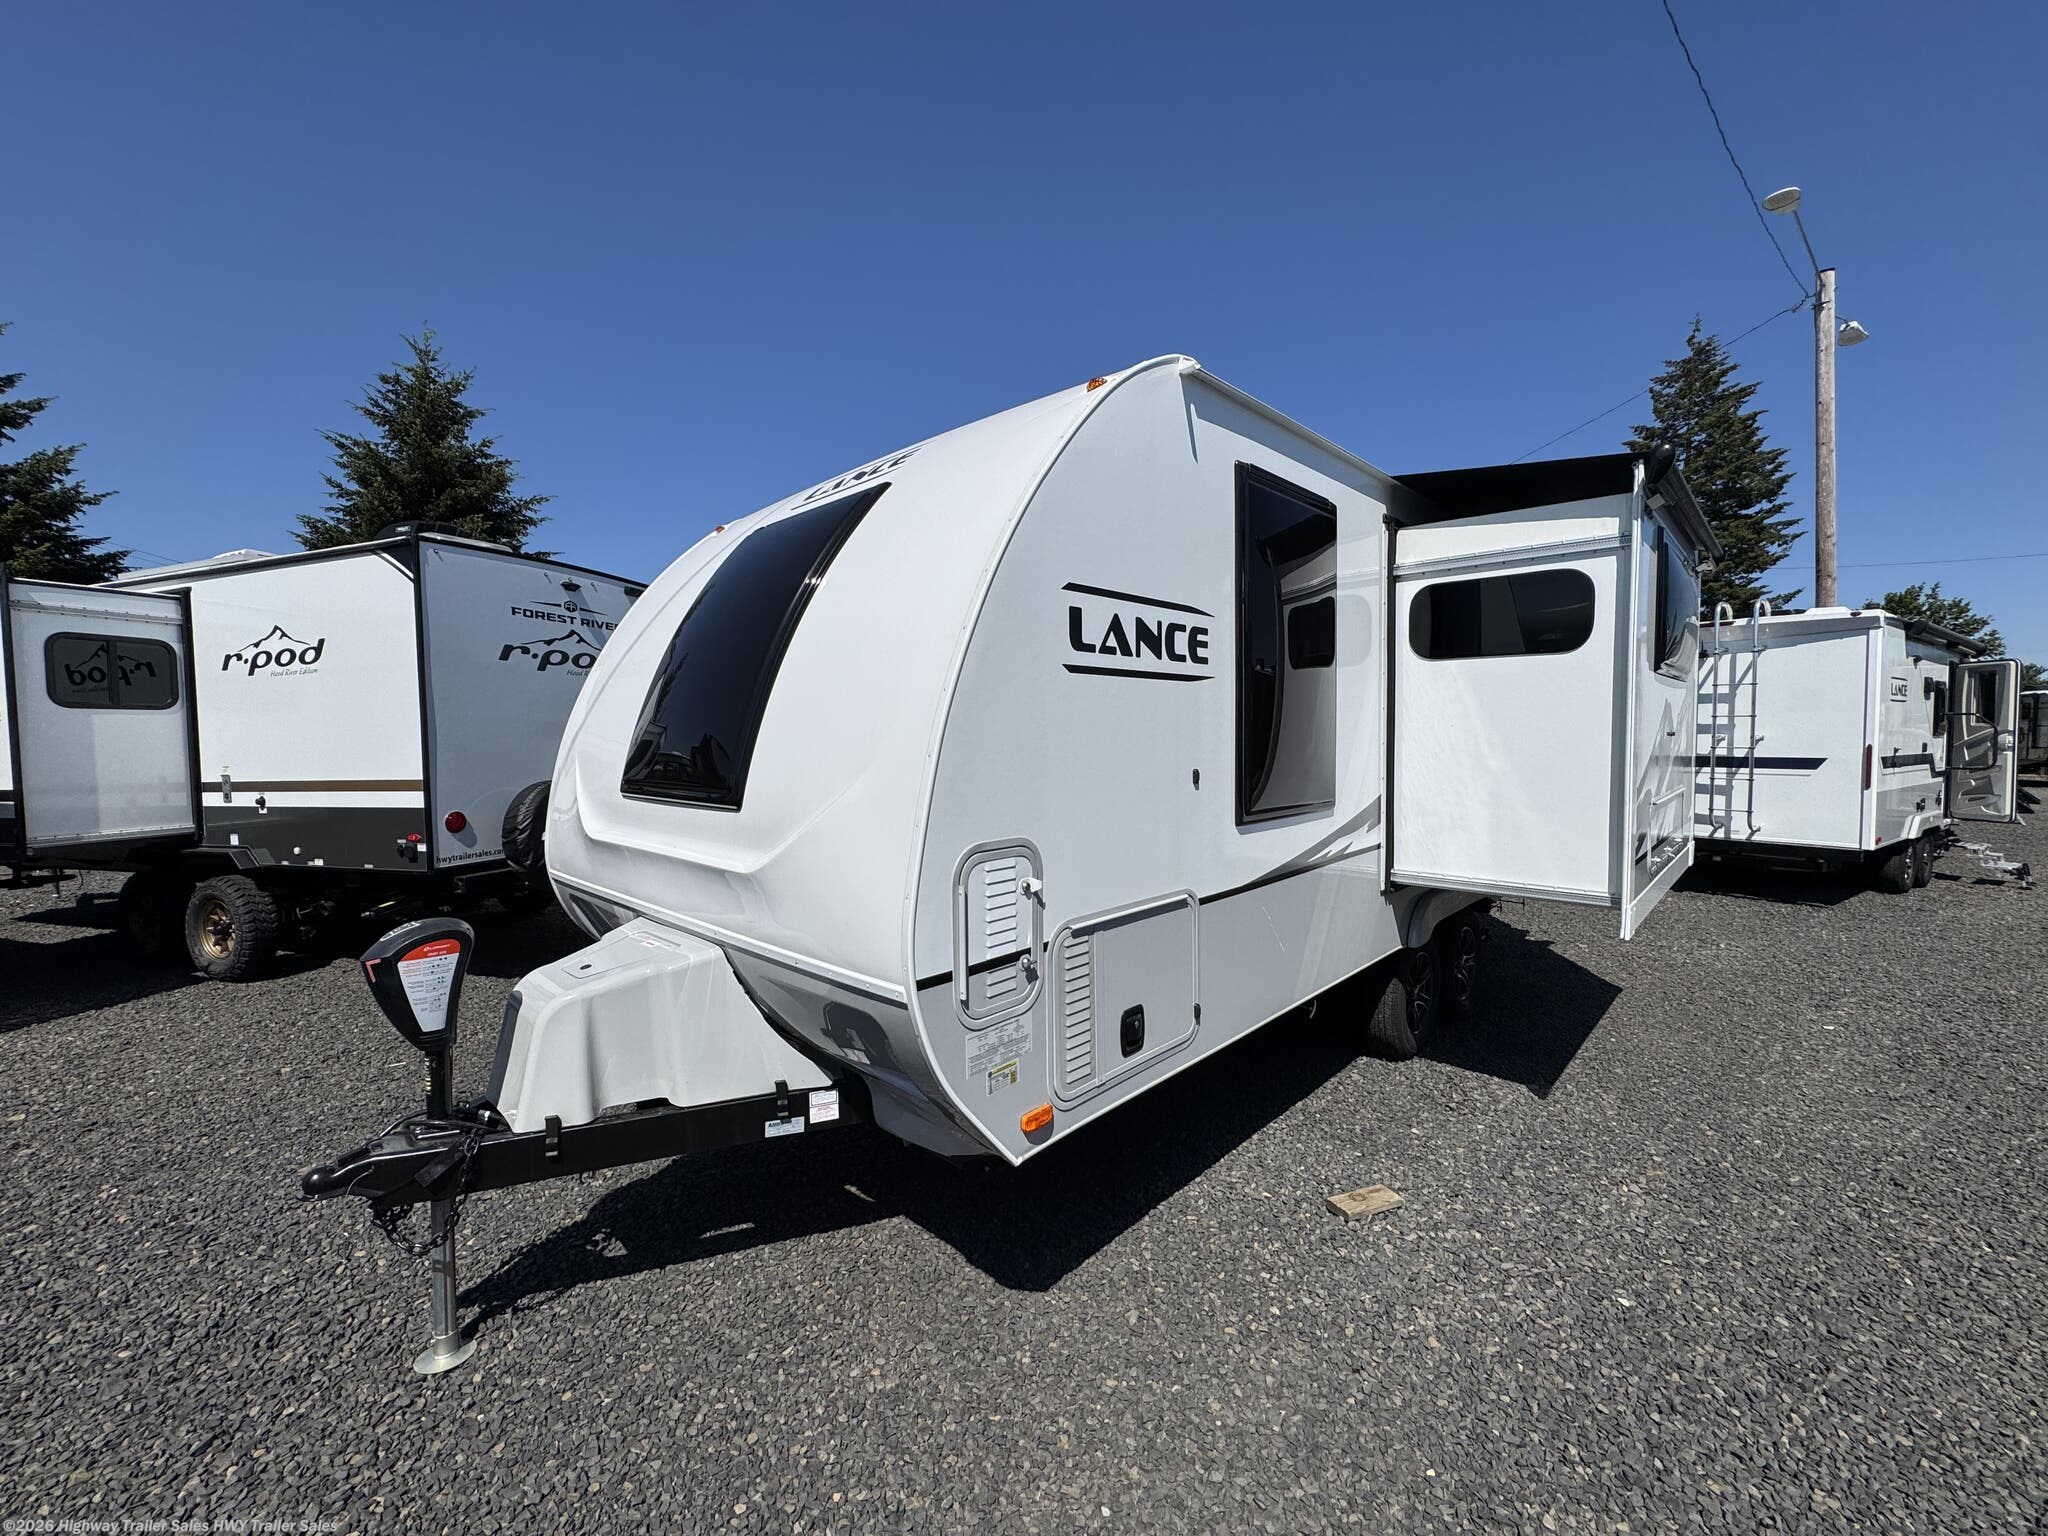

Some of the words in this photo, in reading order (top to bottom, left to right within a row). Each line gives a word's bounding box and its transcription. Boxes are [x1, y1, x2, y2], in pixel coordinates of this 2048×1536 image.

[510, 606, 577, 625] FOREST
[580, 618, 619, 631] RIVE
[1068, 605, 1209, 665] LANCE
[270, 668, 285, 678] Hood
[299, 666, 319, 676] Edition
[1890, 682, 1908, 697] LANCE
